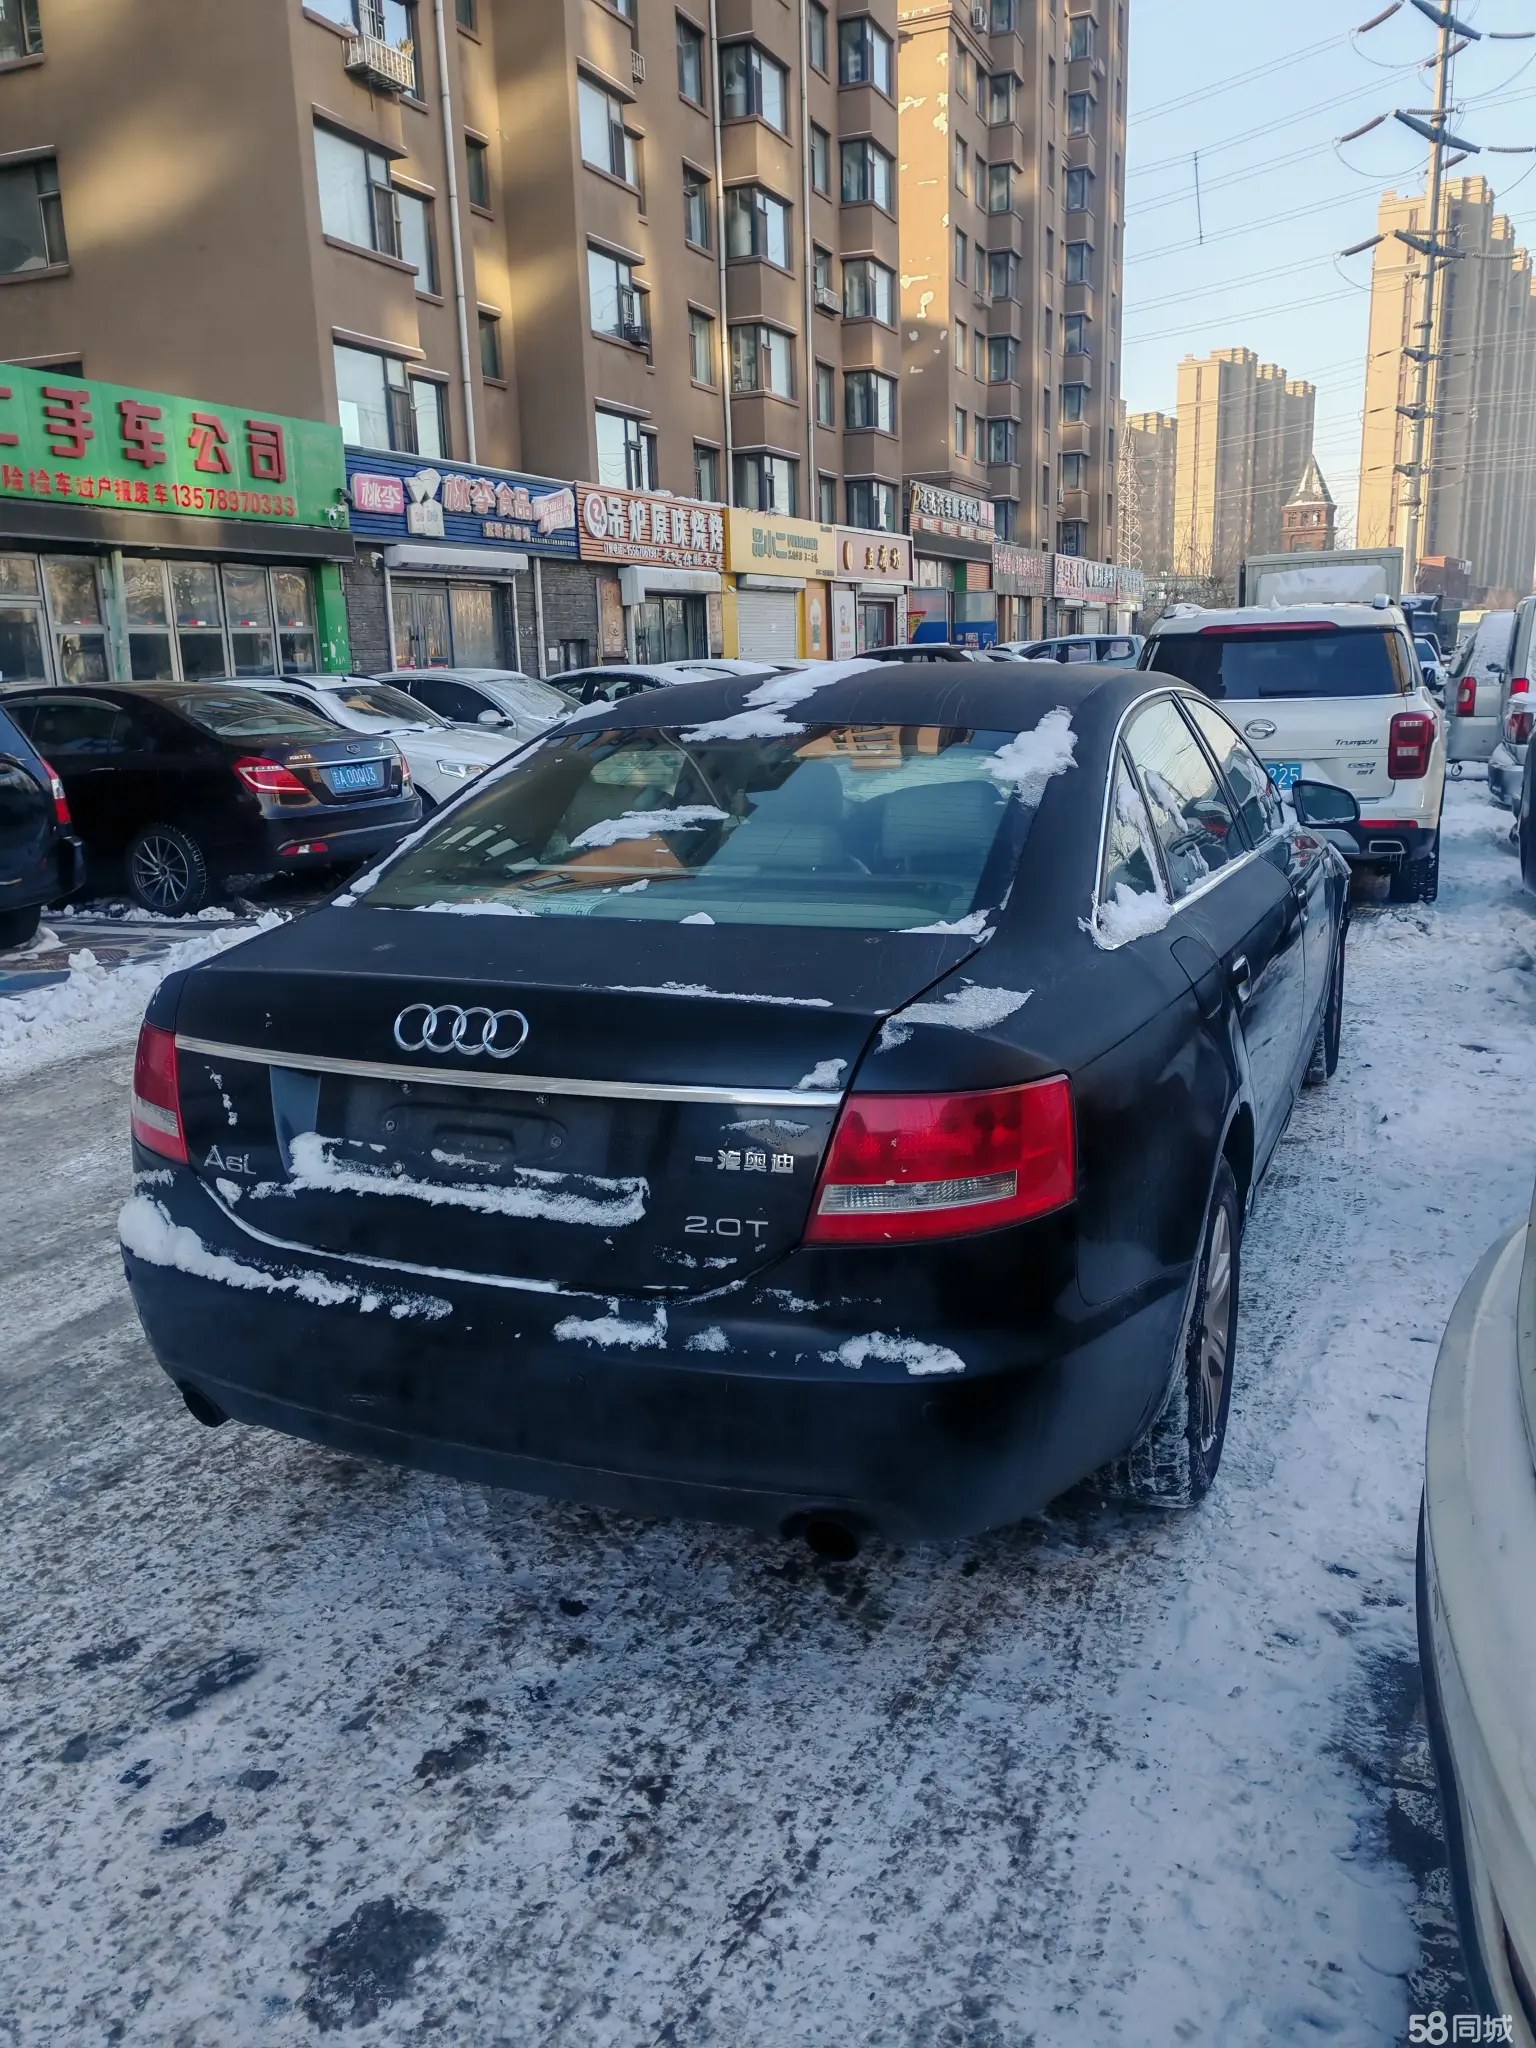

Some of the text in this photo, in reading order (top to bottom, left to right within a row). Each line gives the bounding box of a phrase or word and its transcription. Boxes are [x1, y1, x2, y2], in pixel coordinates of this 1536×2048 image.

[361, 481, 402, 509] 桃李
[442, 474, 533, 521] 桃李食品
[607, 496, 724, 554] 吊炉原味烧烤
[863, 544, 902, 573] 豆腐坊
[1335, 738, 1379, 747] Trumpchi
[694, 1149, 796, 1175] 一汽奥迪
[684, 1215, 769, 1239] 2.0T
